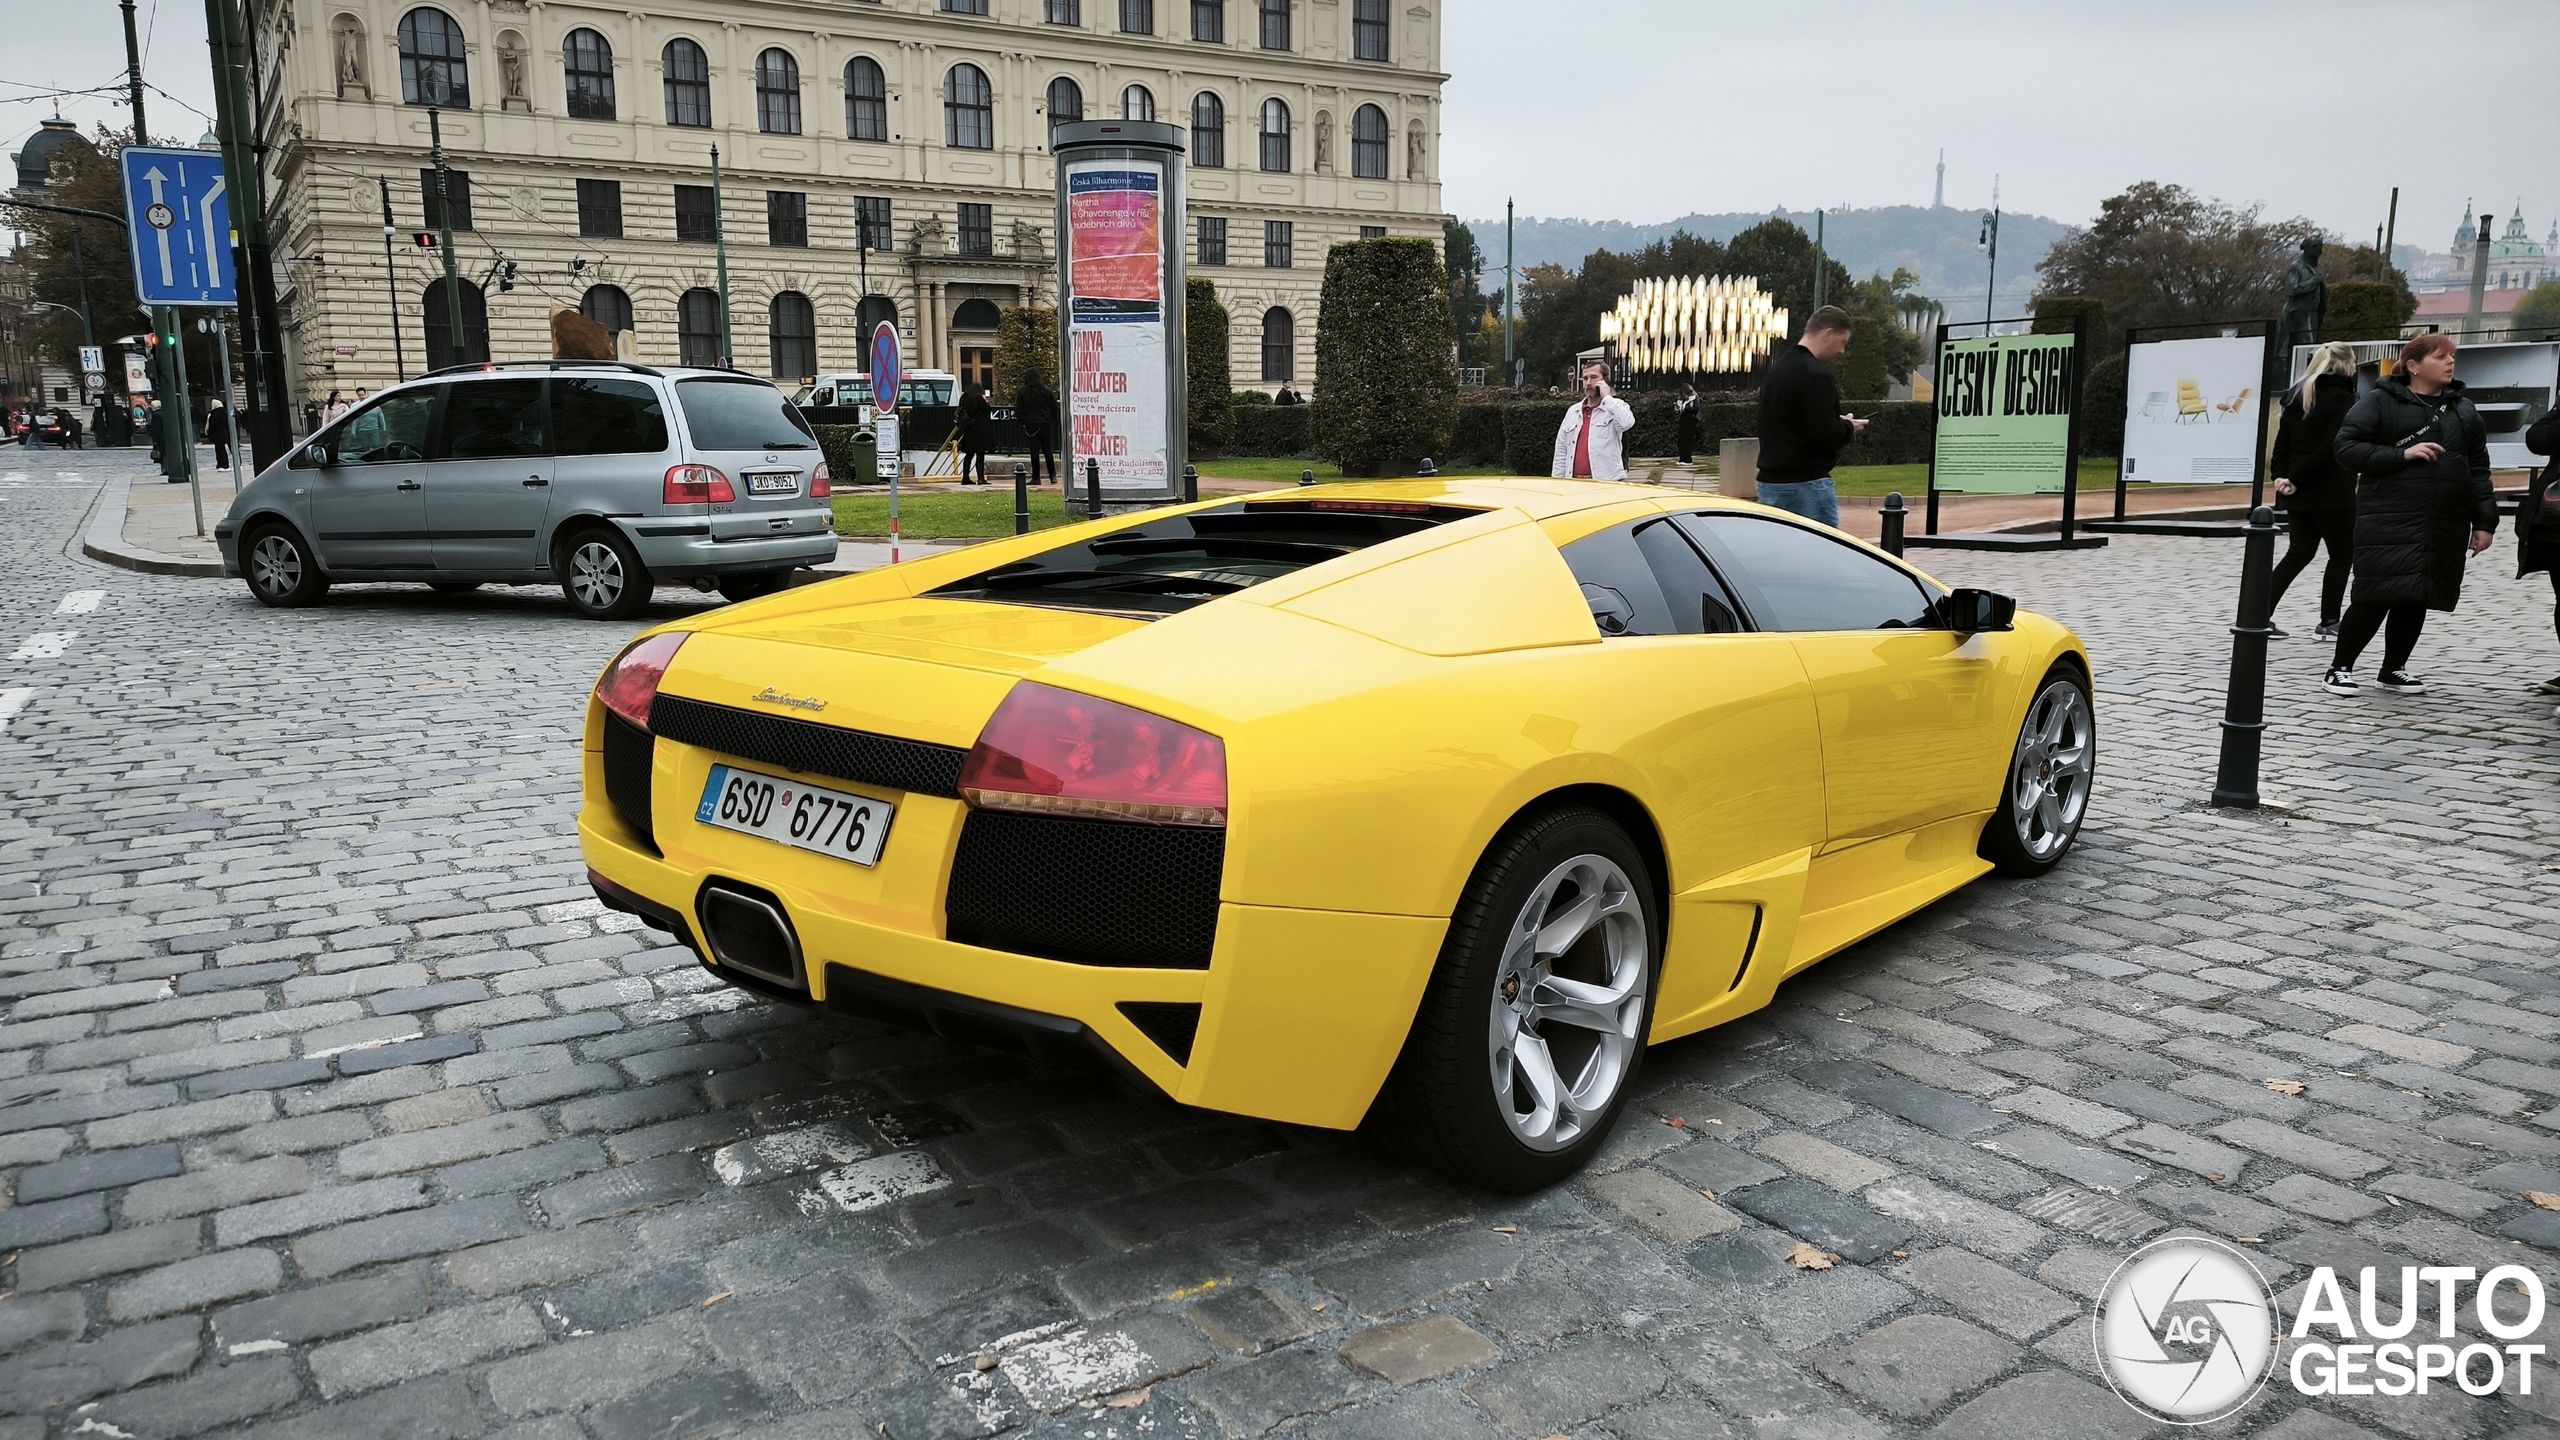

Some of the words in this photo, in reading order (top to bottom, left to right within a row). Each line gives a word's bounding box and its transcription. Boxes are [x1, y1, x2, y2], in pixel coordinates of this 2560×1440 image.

[1072, 177, 1090, 186] Česká
[1092, 176, 1133, 185] filharmonie
[1072, 197, 1099, 207] Martha
[1078, 208, 1129, 219] Čhavorenge
[1074, 219, 1114, 229] hudebních
[1117, 218, 1136, 228] divů
[1072, 331, 1103, 351] TANYA
[1074, 352, 1100, 372] LUKIN
[1073, 372, 1127, 393] LINKLATER
[1941, 341, 2000, 417] ČESKÝ
[2003, 346, 2074, 416] DESIGN
[1098, 404, 1136, 413] mâcistan
[1073, 415, 1106, 435] DUANE
[1075, 435, 1128, 456] LINKLATER
[1119, 459, 1164, 467] Rudolfinum
[1148, 468, 1164, 476] 2027
[700, 801, 714, 816] CZ
[721, 777, 775, 828] 6SD
[790, 793, 870, 853] 6776
